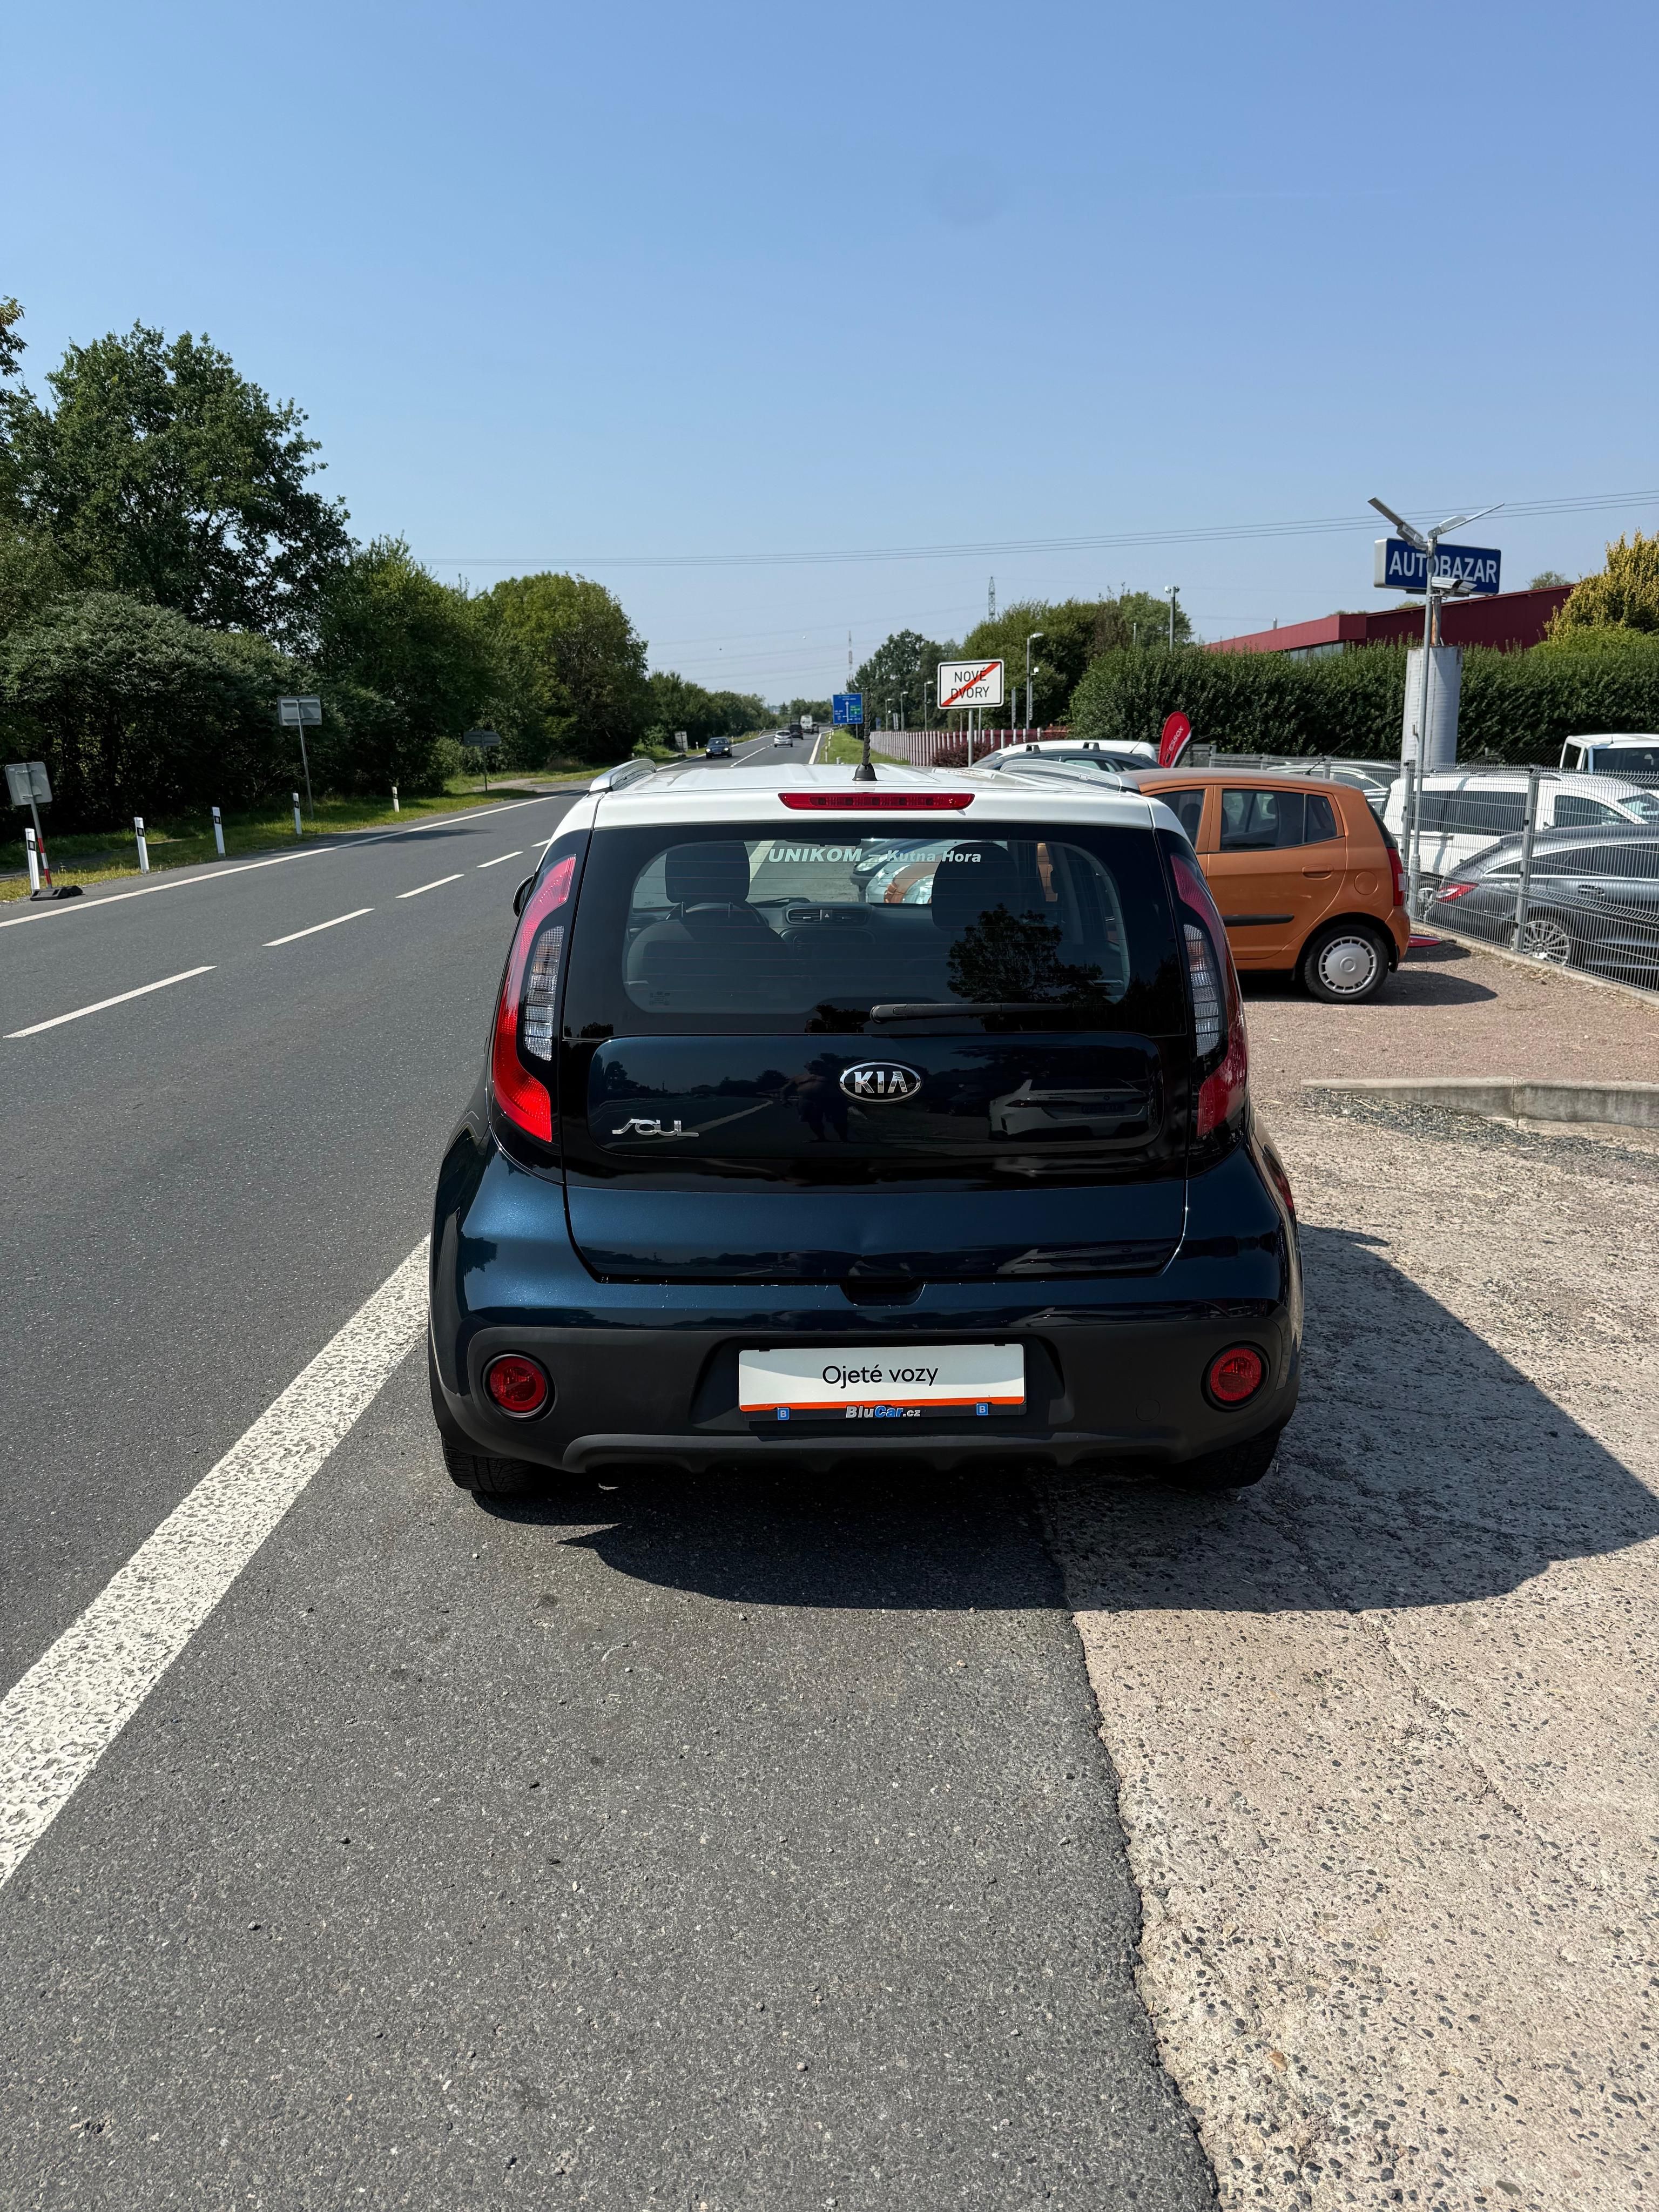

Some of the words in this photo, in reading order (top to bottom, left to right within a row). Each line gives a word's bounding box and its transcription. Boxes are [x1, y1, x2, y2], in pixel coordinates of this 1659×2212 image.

[1388, 550, 1497, 584] AUTOBAZAR
[954, 667, 987, 683] NOVÉ
[951, 686, 989, 699] DVORY
[768, 848, 862, 862] UNIKOM
[886, 850, 936, 862] Kutna
[942, 851, 981, 862] Hora
[854, 1071, 908, 1093] KIA
[822, 1364, 882, 1389] Ojeté
[889, 1368, 939, 1386] vozy
[846, 1405, 921, 1419] BluCar.cz
